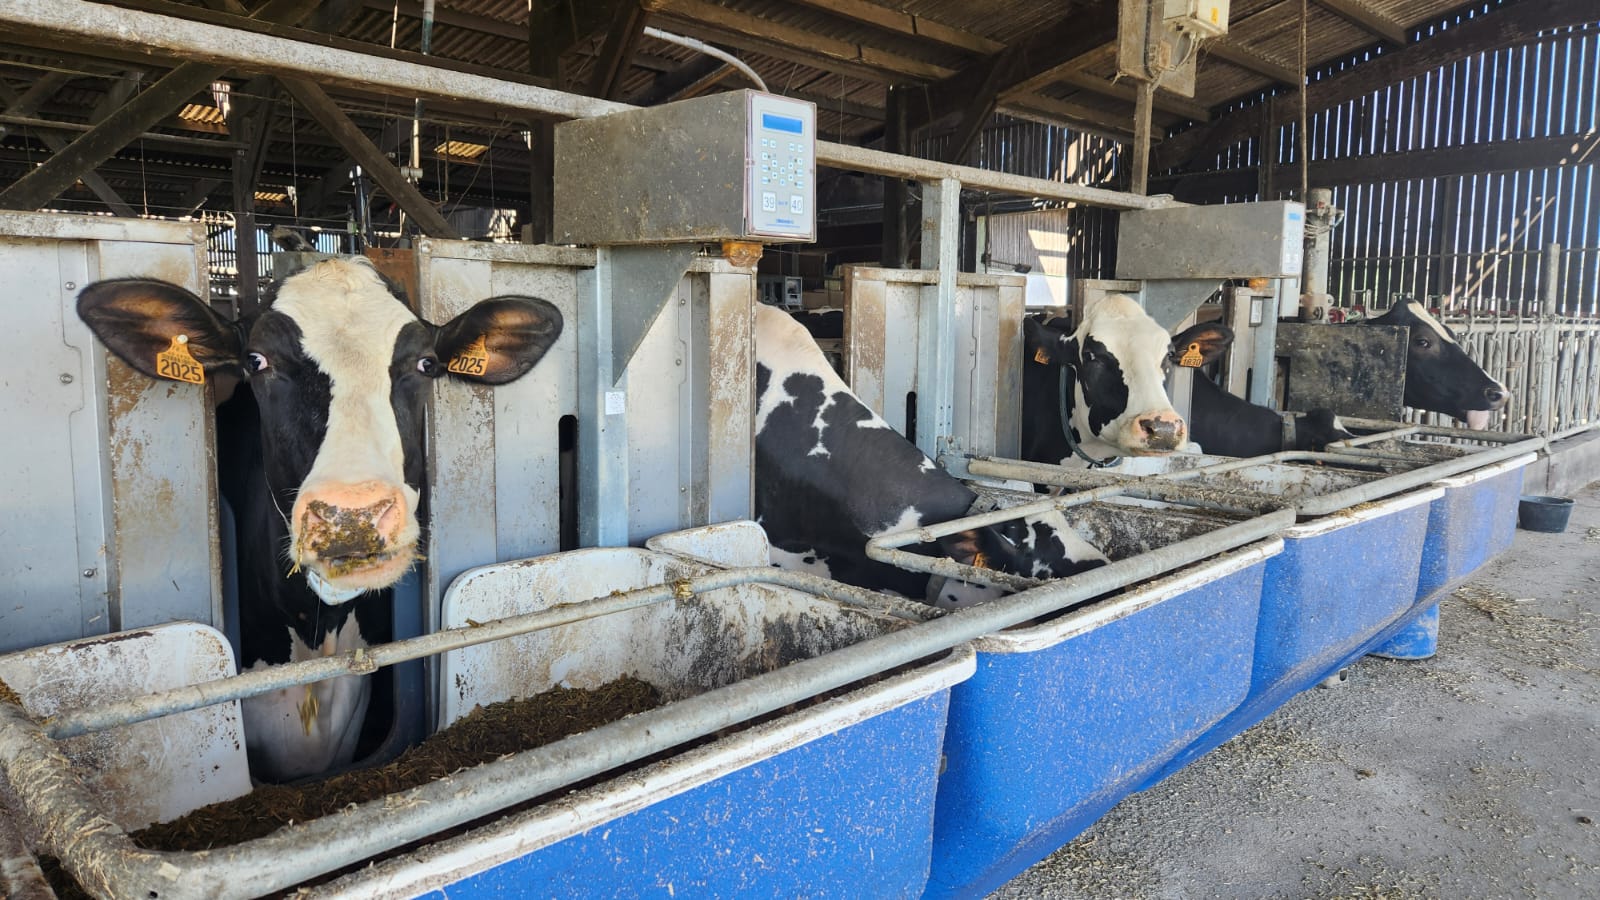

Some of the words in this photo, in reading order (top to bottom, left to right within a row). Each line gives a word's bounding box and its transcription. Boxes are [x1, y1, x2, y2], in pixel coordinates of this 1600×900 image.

[764, 196, 775, 209] 39
[792, 199, 802, 211] 40
[161, 358, 201, 382] 2025
[450, 356, 485, 374] 2025
